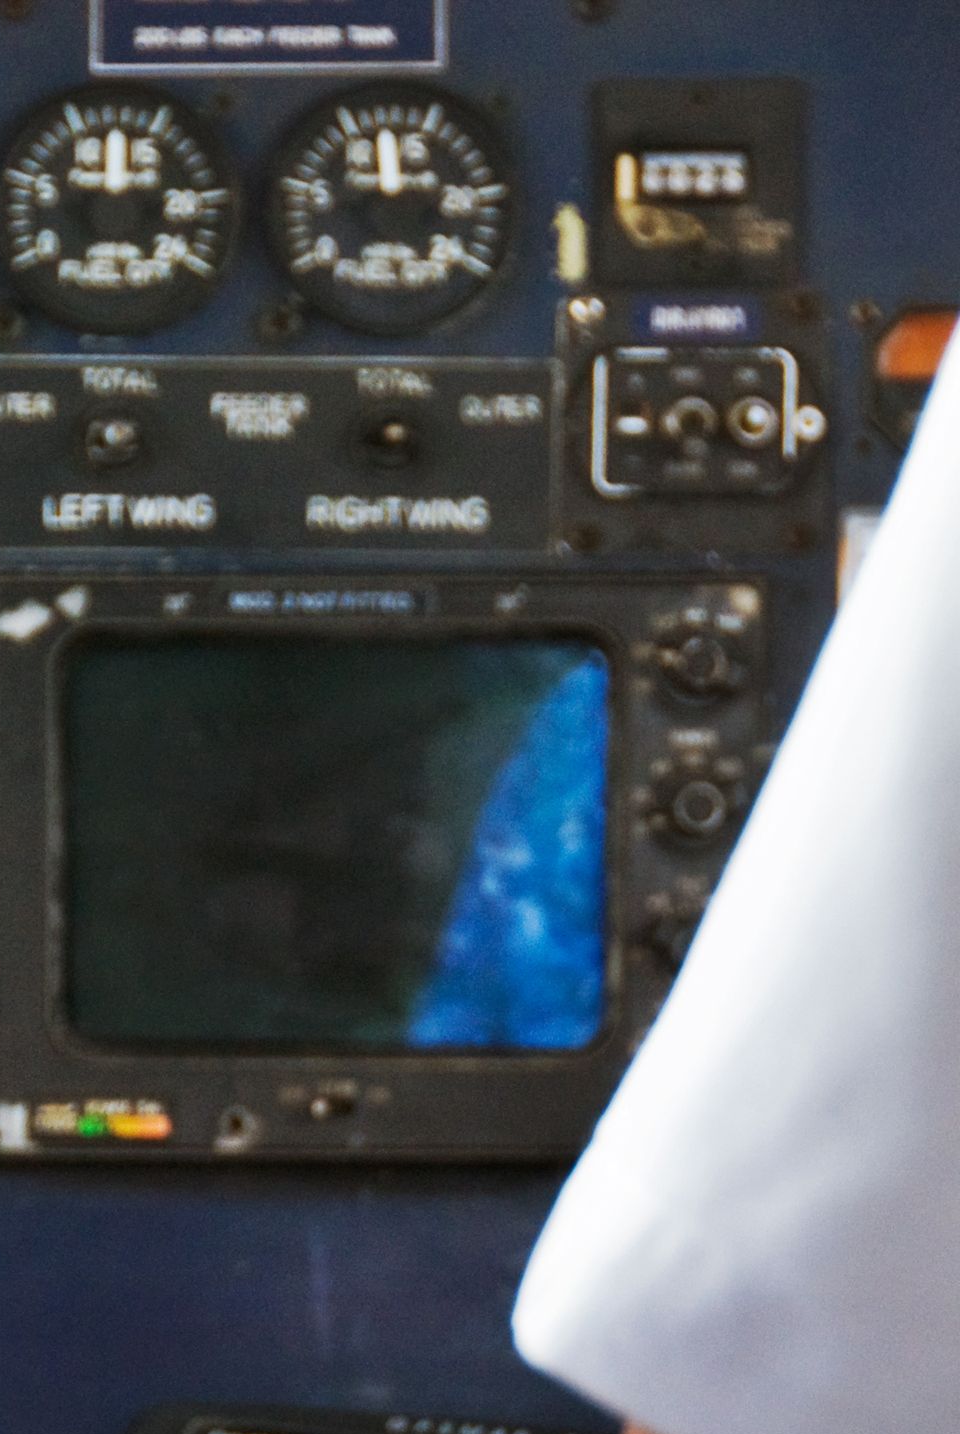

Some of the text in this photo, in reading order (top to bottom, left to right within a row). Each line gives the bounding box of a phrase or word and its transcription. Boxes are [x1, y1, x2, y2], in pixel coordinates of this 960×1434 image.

[43, 494, 215, 530] LEFT WING
[306, 495, 490, 531] RIGHT WING
